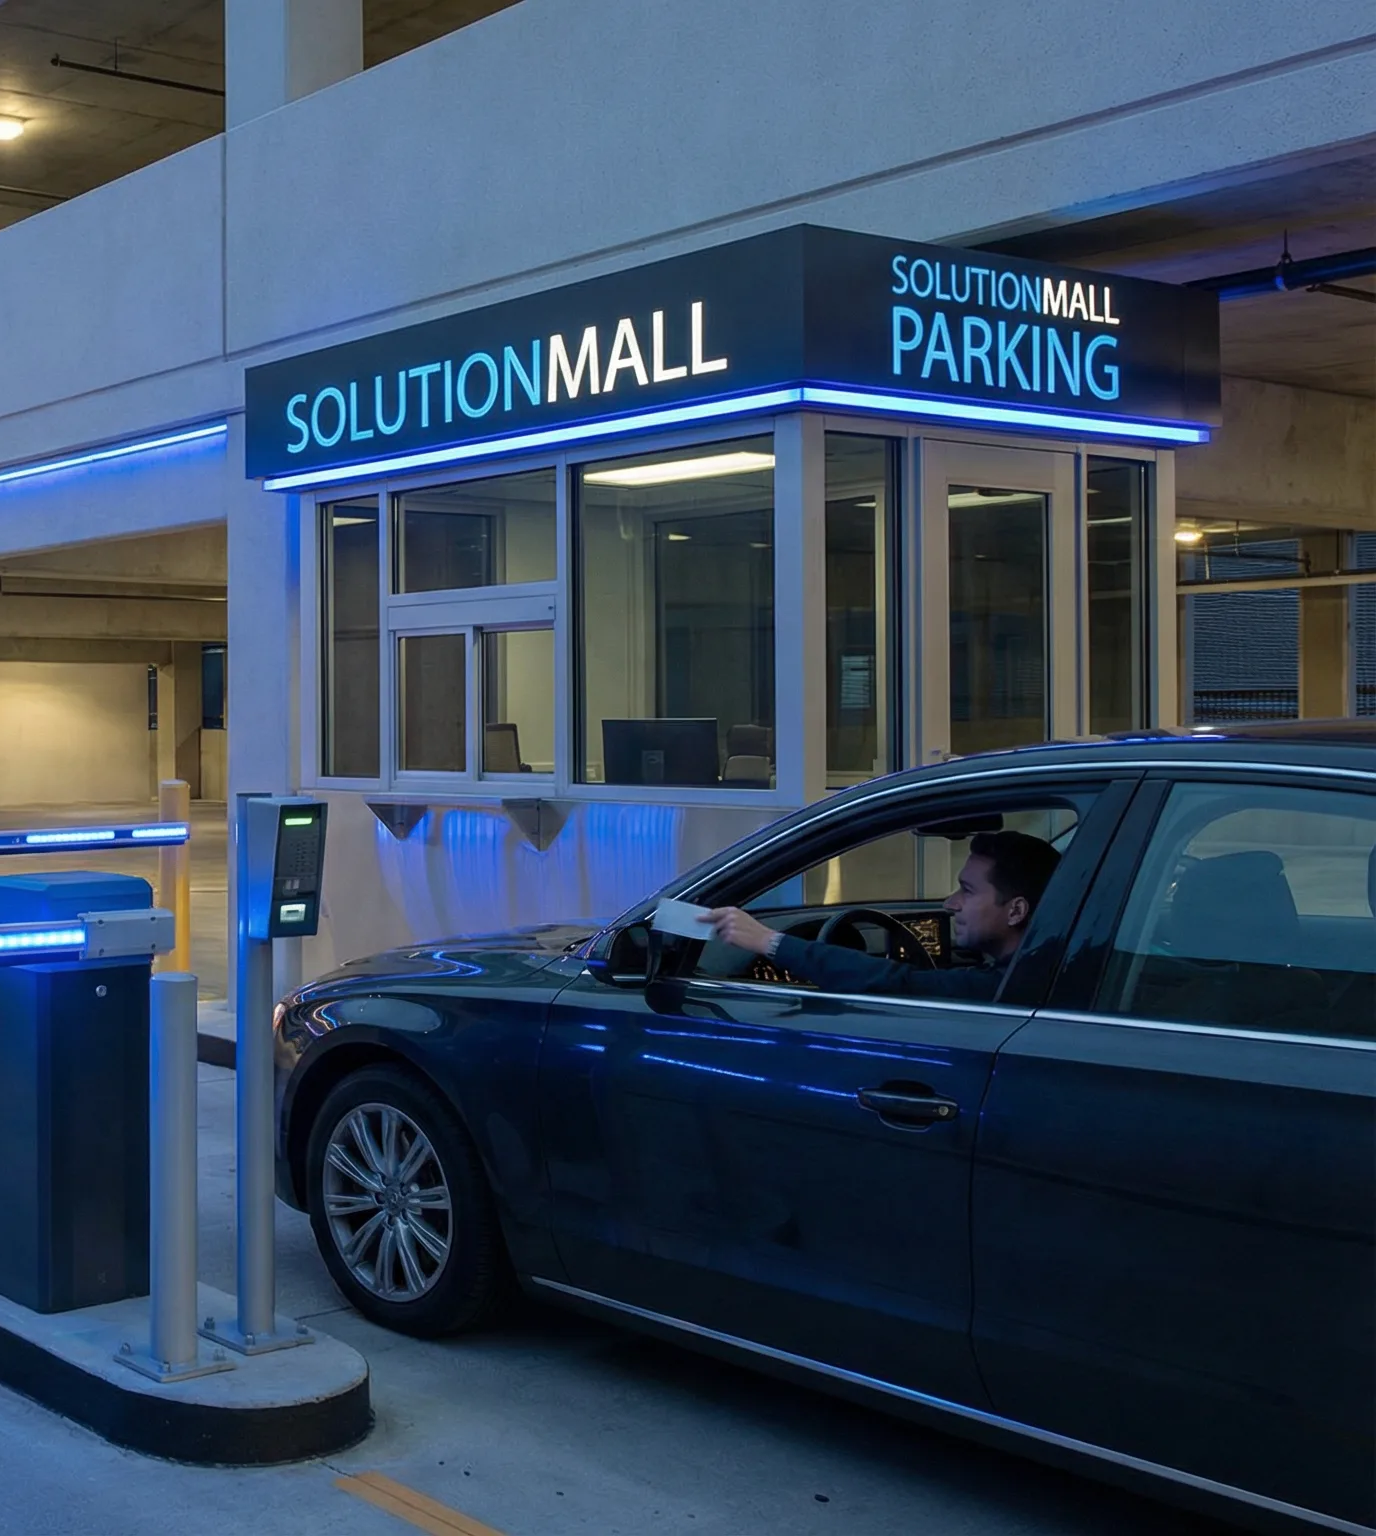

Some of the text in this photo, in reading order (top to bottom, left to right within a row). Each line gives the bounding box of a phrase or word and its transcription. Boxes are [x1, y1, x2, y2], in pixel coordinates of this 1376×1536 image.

[892, 255, 1120, 325] SOLUTIONMALL
[286, 302, 728, 454] SOLUTIONMALL
[892, 306, 1120, 401] PARKING
